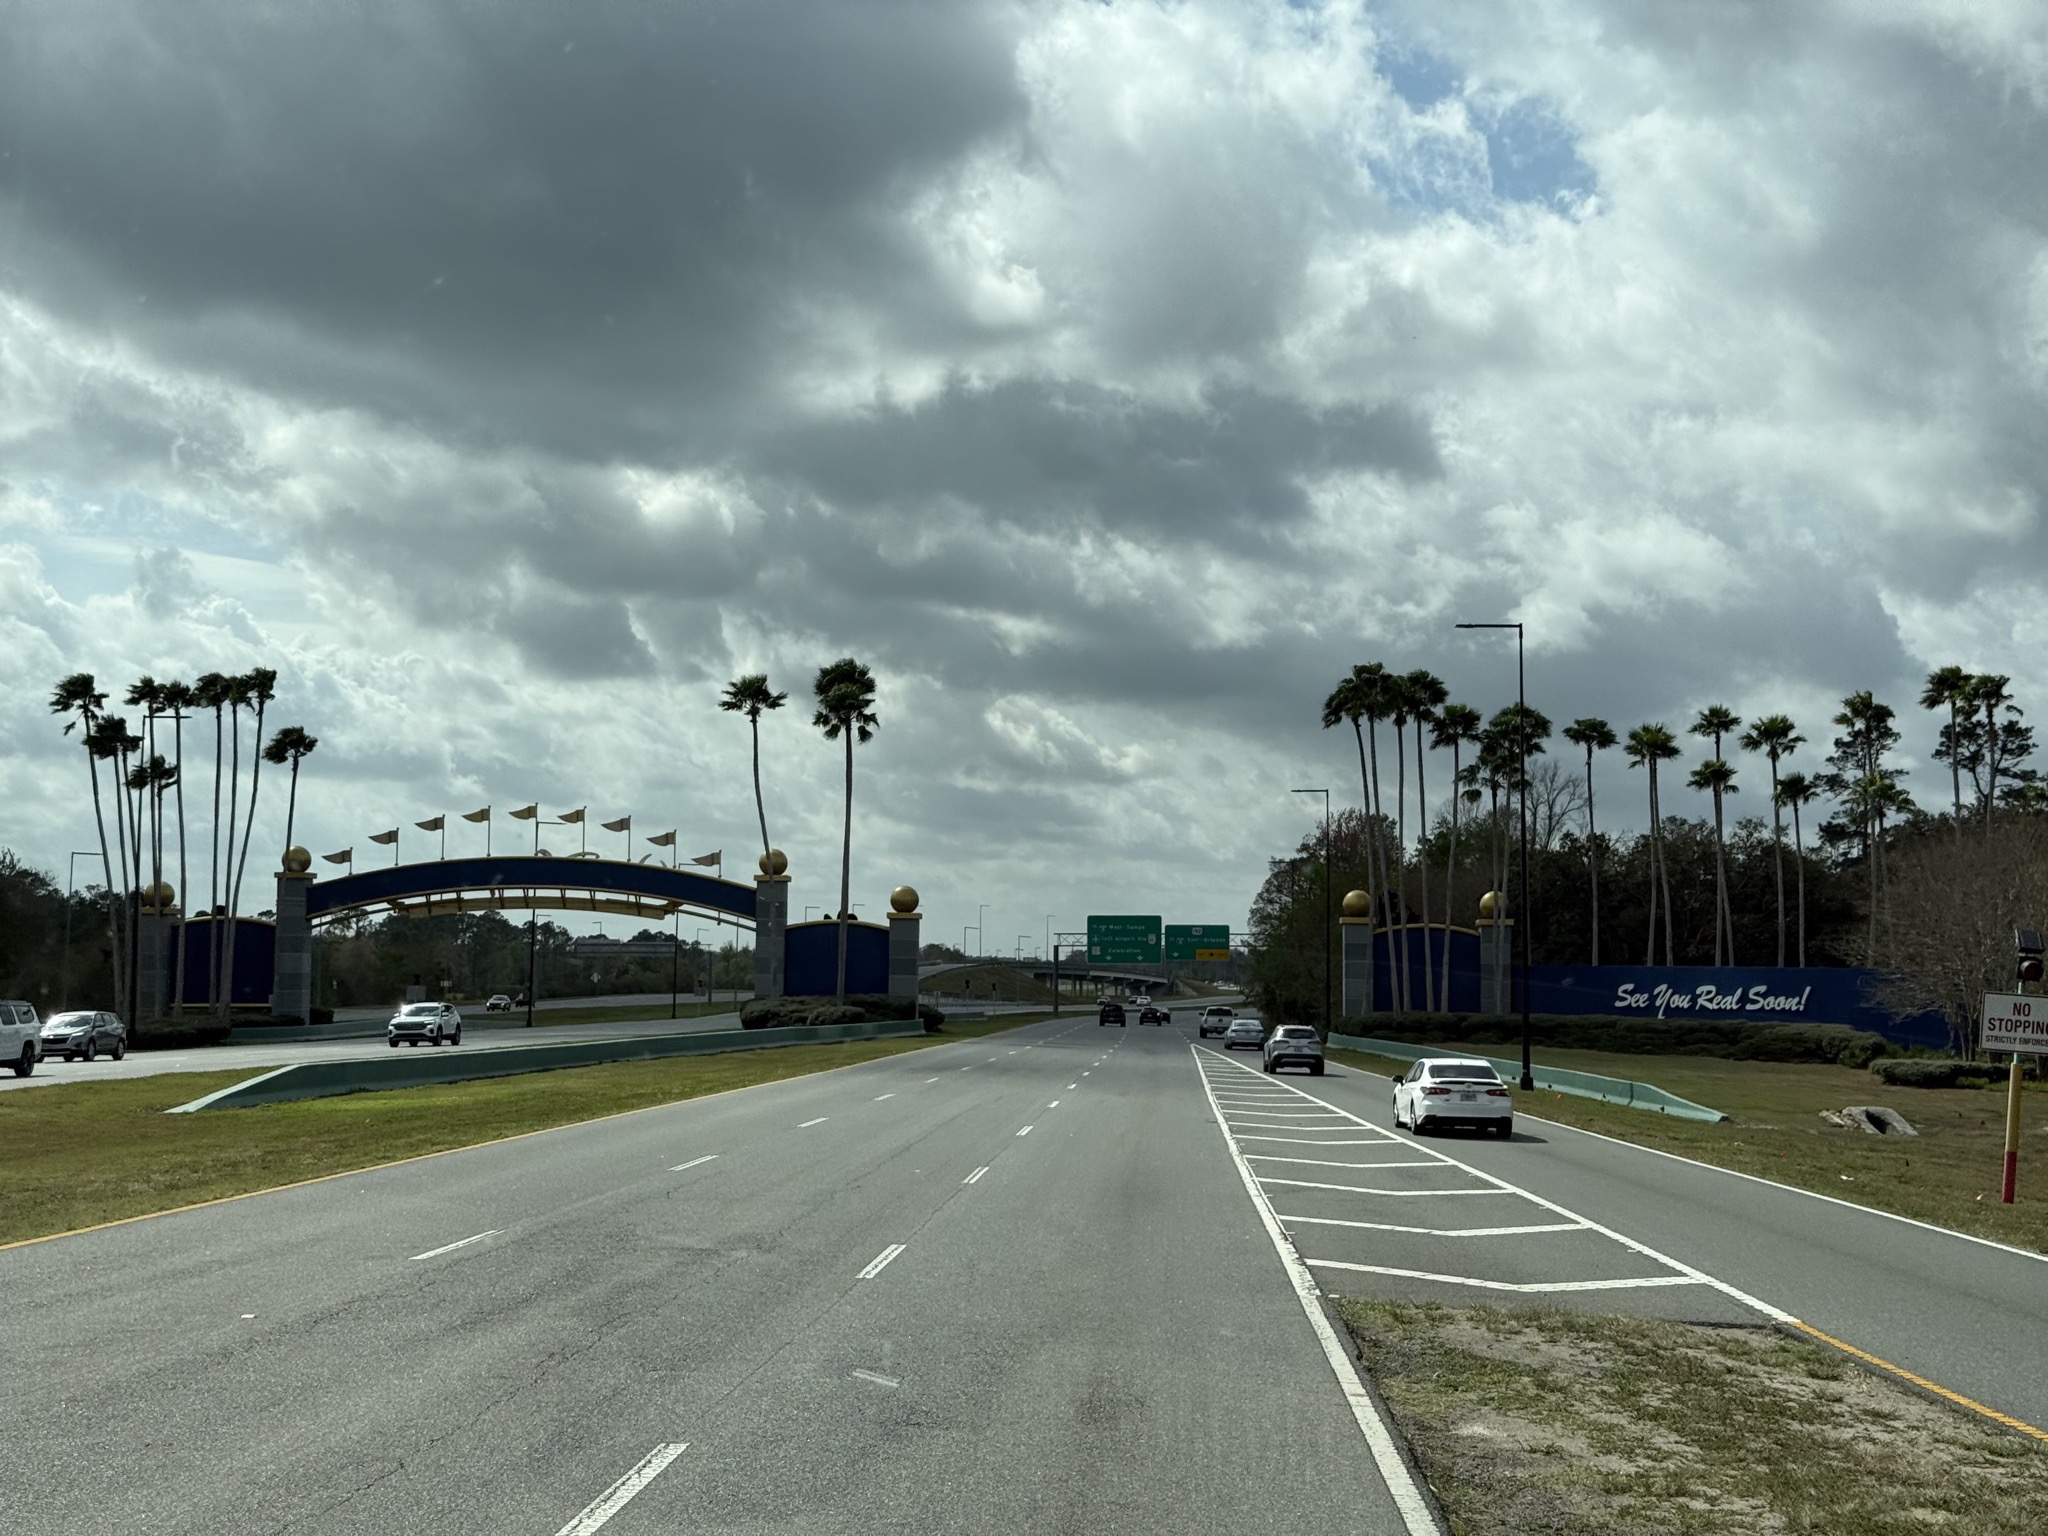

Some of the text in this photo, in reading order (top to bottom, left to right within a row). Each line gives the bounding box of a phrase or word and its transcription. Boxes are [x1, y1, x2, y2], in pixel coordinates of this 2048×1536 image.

[1614, 983, 1812, 1020] See You Real Soon!
[2012, 1002, 2031, 1017] NO
[1985, 1034, 2017, 1044] STRICTLY
